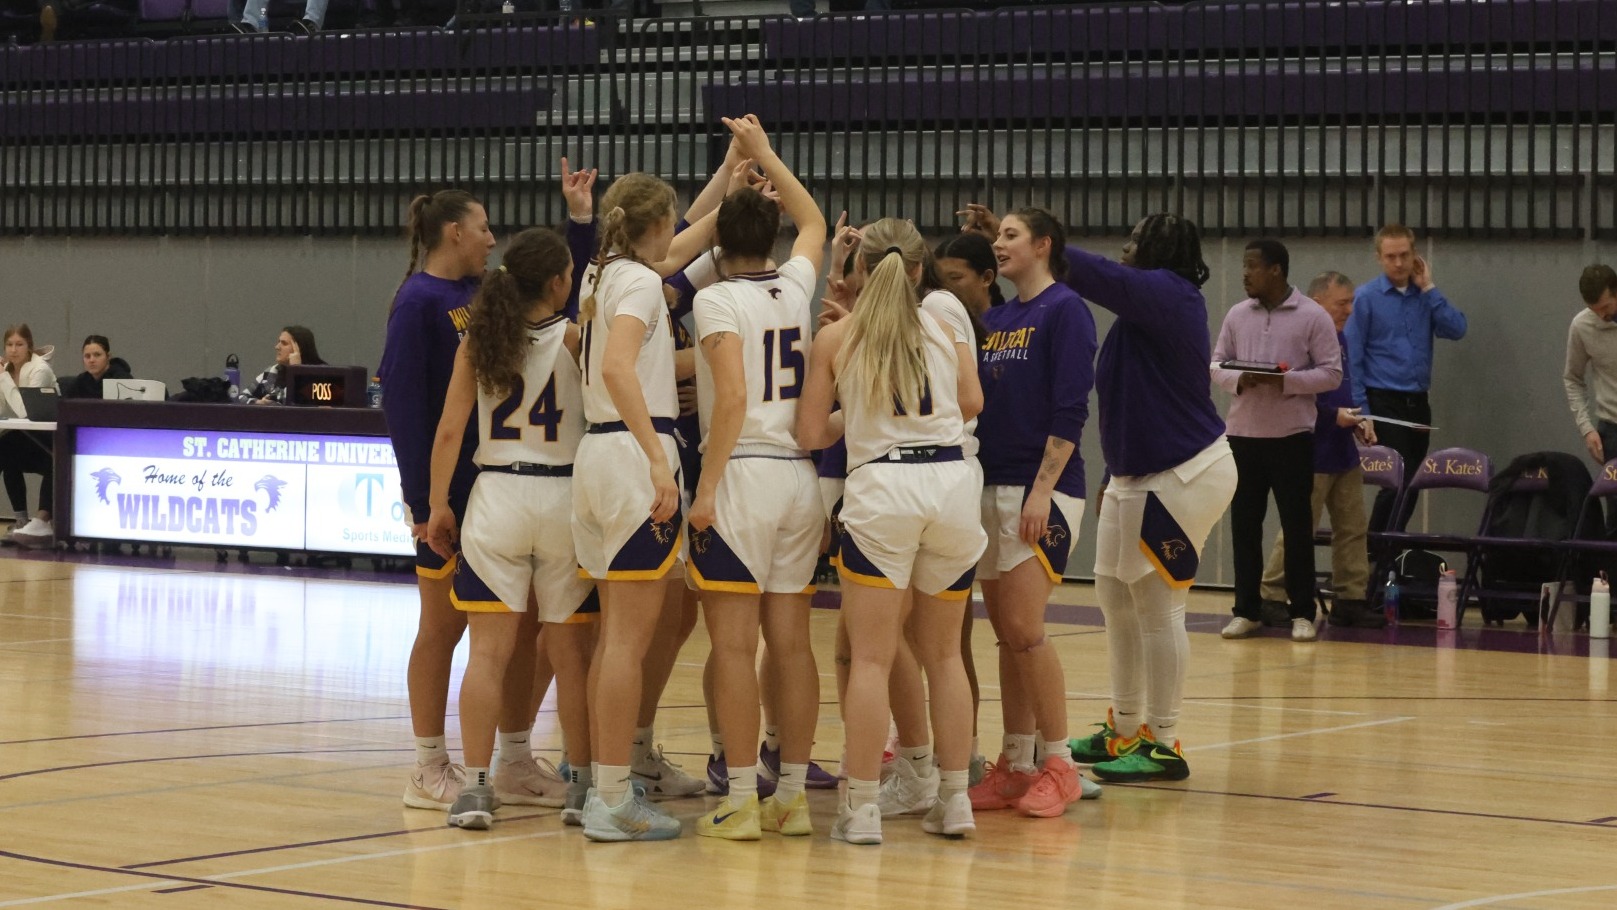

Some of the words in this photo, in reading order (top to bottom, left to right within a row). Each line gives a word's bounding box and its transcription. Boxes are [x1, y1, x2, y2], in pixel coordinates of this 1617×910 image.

[762, 326, 806, 402] 15
[312, 382, 331, 400] POSS
[490, 370, 564, 442] 24
[182, 436, 212, 459] ST.
[216, 437, 319, 462] CATHERINE
[143, 465, 186, 485] Home
[192, 470, 208, 492] of
[212, 469, 234, 488] the
[1424, 458, 1441, 474] St.
[1445, 459, 1483, 475] Kate's
[116, 493, 258, 537] WILDCATS
[342, 527, 379, 543] Sports
